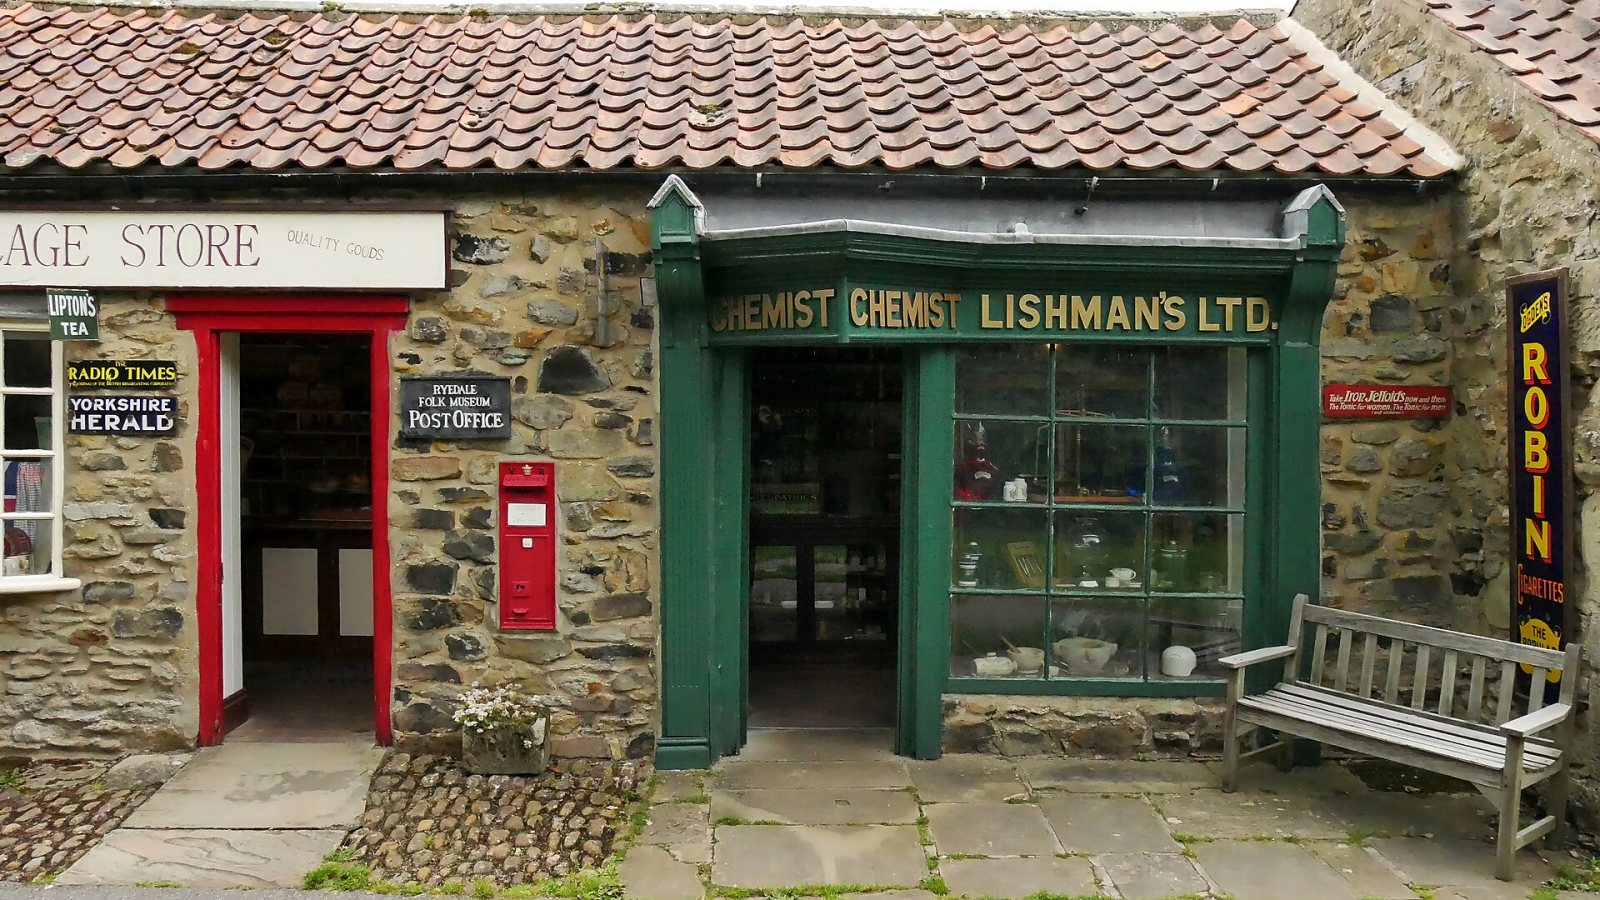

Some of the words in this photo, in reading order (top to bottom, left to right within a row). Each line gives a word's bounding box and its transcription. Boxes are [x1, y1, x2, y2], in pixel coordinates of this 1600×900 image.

[0, 222, 90, 268] AGE
[120, 223, 261, 268] STORE
[346, 242, 385, 261] GOODS
[48, 293, 96, 318] LIPTON'S
[709, 288, 835, 333] CHEMIST
[850, 287, 961, 330] CHEMIST
[981, 291, 1186, 332] LISHMAN'S
[1199, 295, 1278, 333] LTD.
[61, 322, 89, 336] TEA
[68, 367, 120, 381] RADIO
[125, 367, 176, 381] TIMES
[433, 384, 477, 395] RYEDALE
[1329, 394, 1344, 403] Take
[1344, 390, 1366, 402] Iron
[1365, 390, 1406, 403] Jelloids
[1419, 395, 1430, 403] and
[70, 398, 171, 412] YORKSHIRE
[418, 396, 446, 407] FOLK
[449, 396, 491, 407] MUSEUM
[1393, 403, 1404, 411] The
[1404, 403, 1421, 411] Tonic
[71, 414, 174, 431] HERALD
[409, 410, 452, 428] POST
[452, 409, 504, 429] OFFICE
[1522, 342, 1553, 564] ROBIN
[1517, 563, 1564, 605] CIGARETTES
[1532, 625, 1547, 641] THE
